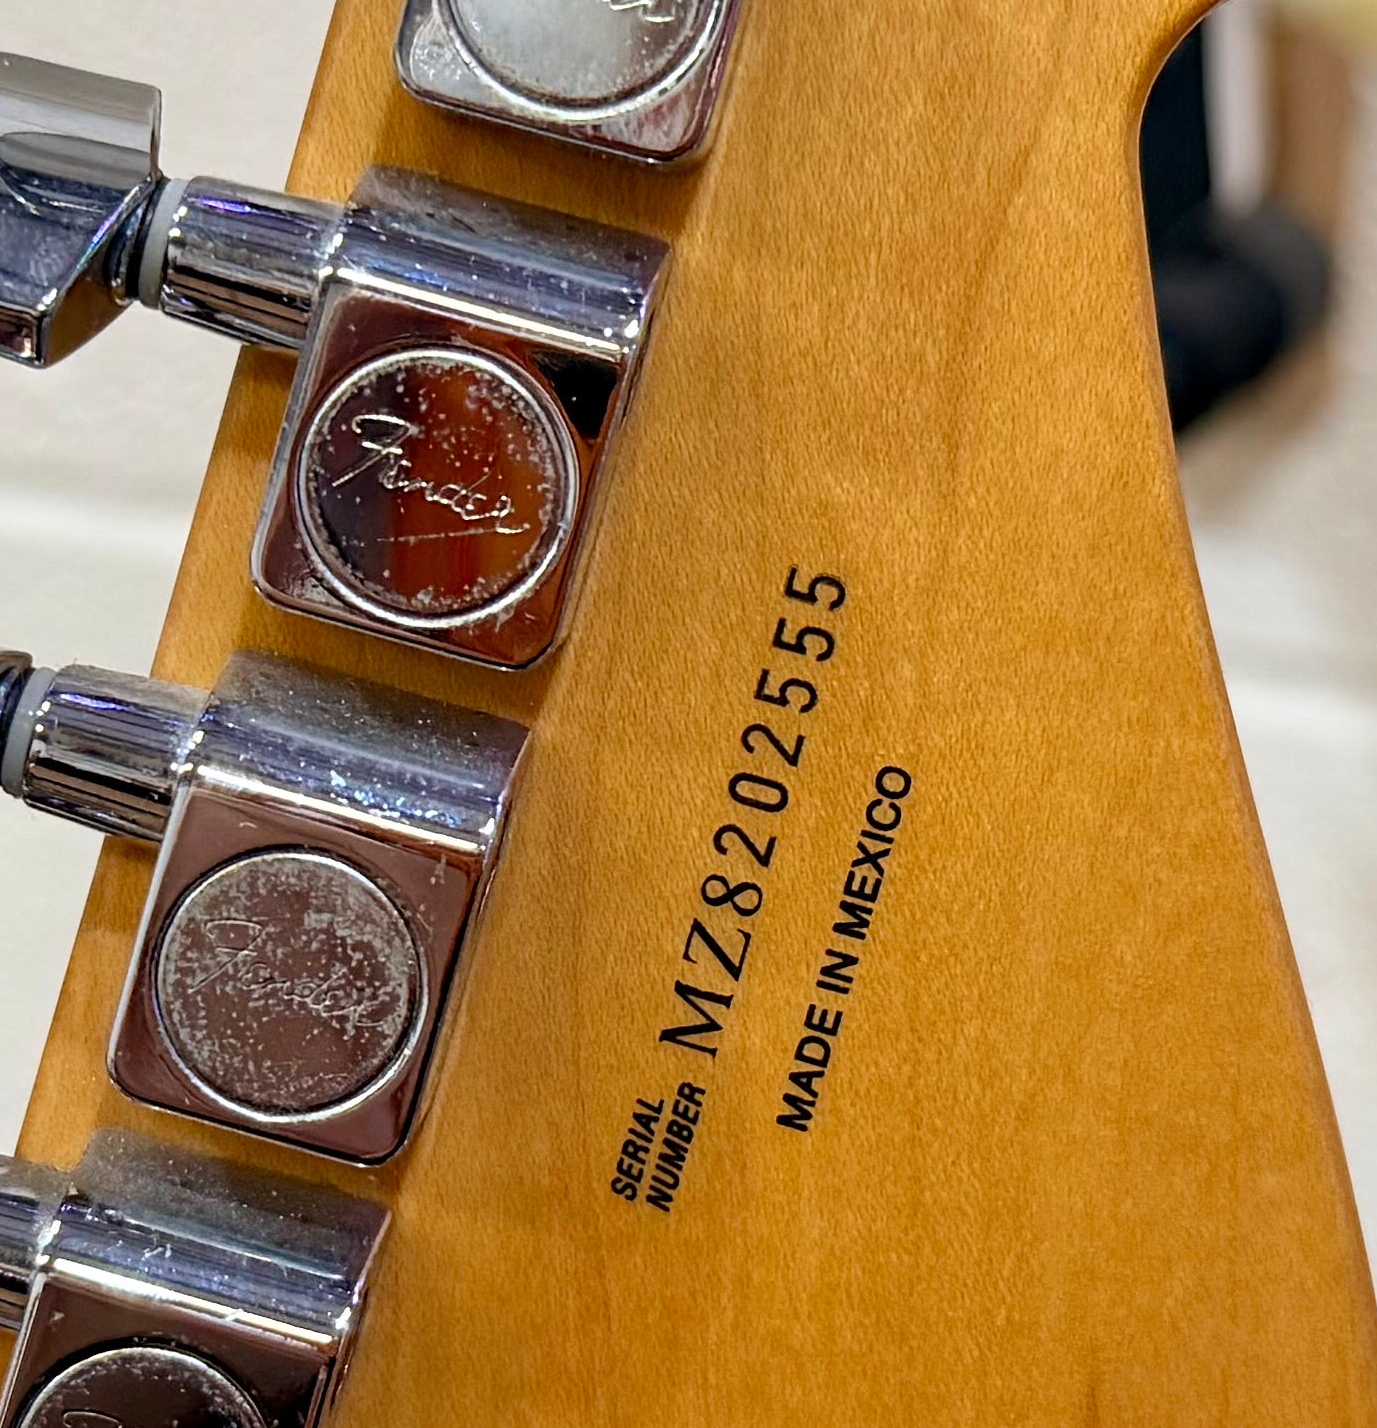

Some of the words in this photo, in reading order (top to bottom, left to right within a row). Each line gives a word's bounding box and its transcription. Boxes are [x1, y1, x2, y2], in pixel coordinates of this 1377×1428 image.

[332, 413, 531, 535] Fender
[657, 563, 847, 1060] MZ8202555
[831, 765, 913, 941] MEXICO
[817, 947, 860, 996] IN
[775, 1002, 844, 1133] MADE
[609, 1096, 665, 1204] SERIAL
[644, 1080, 707, 1214] NUMBER
